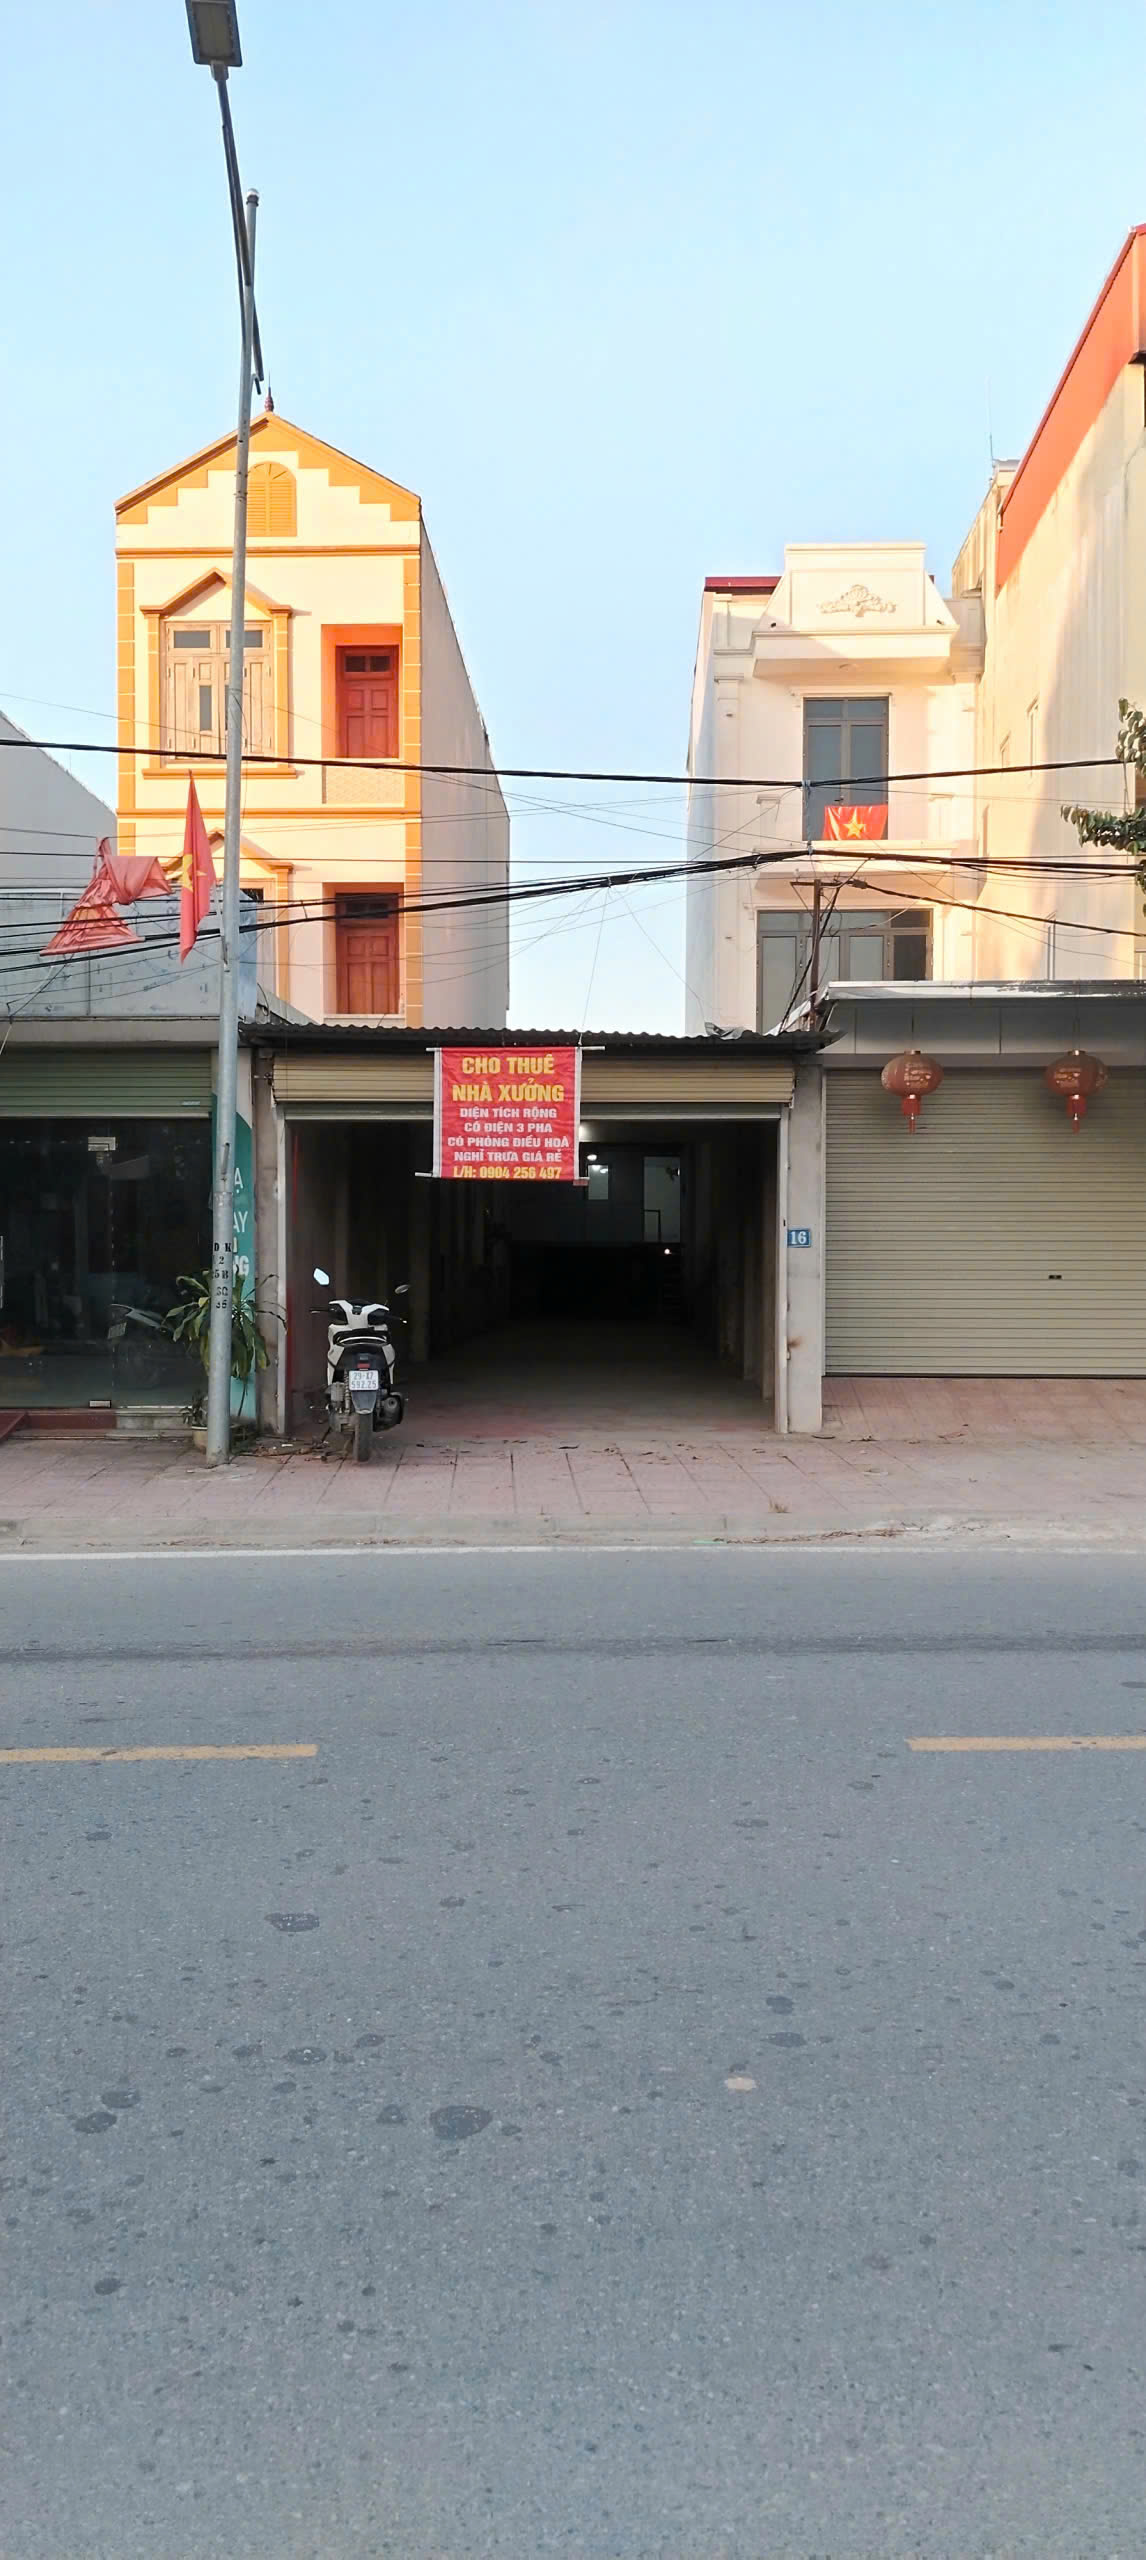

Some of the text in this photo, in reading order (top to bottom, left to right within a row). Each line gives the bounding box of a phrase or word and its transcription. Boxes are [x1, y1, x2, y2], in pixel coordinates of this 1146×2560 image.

[462, 1053, 555, 1074] CHO THUÊ
[452, 1077, 565, 1102] NHÀ XƯỞNG
[460, 1106, 558, 1120] DIỆN TÍCH RỘNG
[464, 1121, 553, 1134] CÓ ĐIỆN 3 PHA
[447, 1135, 464, 1147] CÓ
[467, 1135, 510, 1147] PHÒNG
[454, 1148, 562, 1162] NGHỈ TRƯA GIÁ RẺ
[453, 1165, 477, 1178] L/H:
[479, 1166, 510, 1179] 0904
[539, 1166, 562, 1179] 497
[791, 1231, 807, 1245] 16
